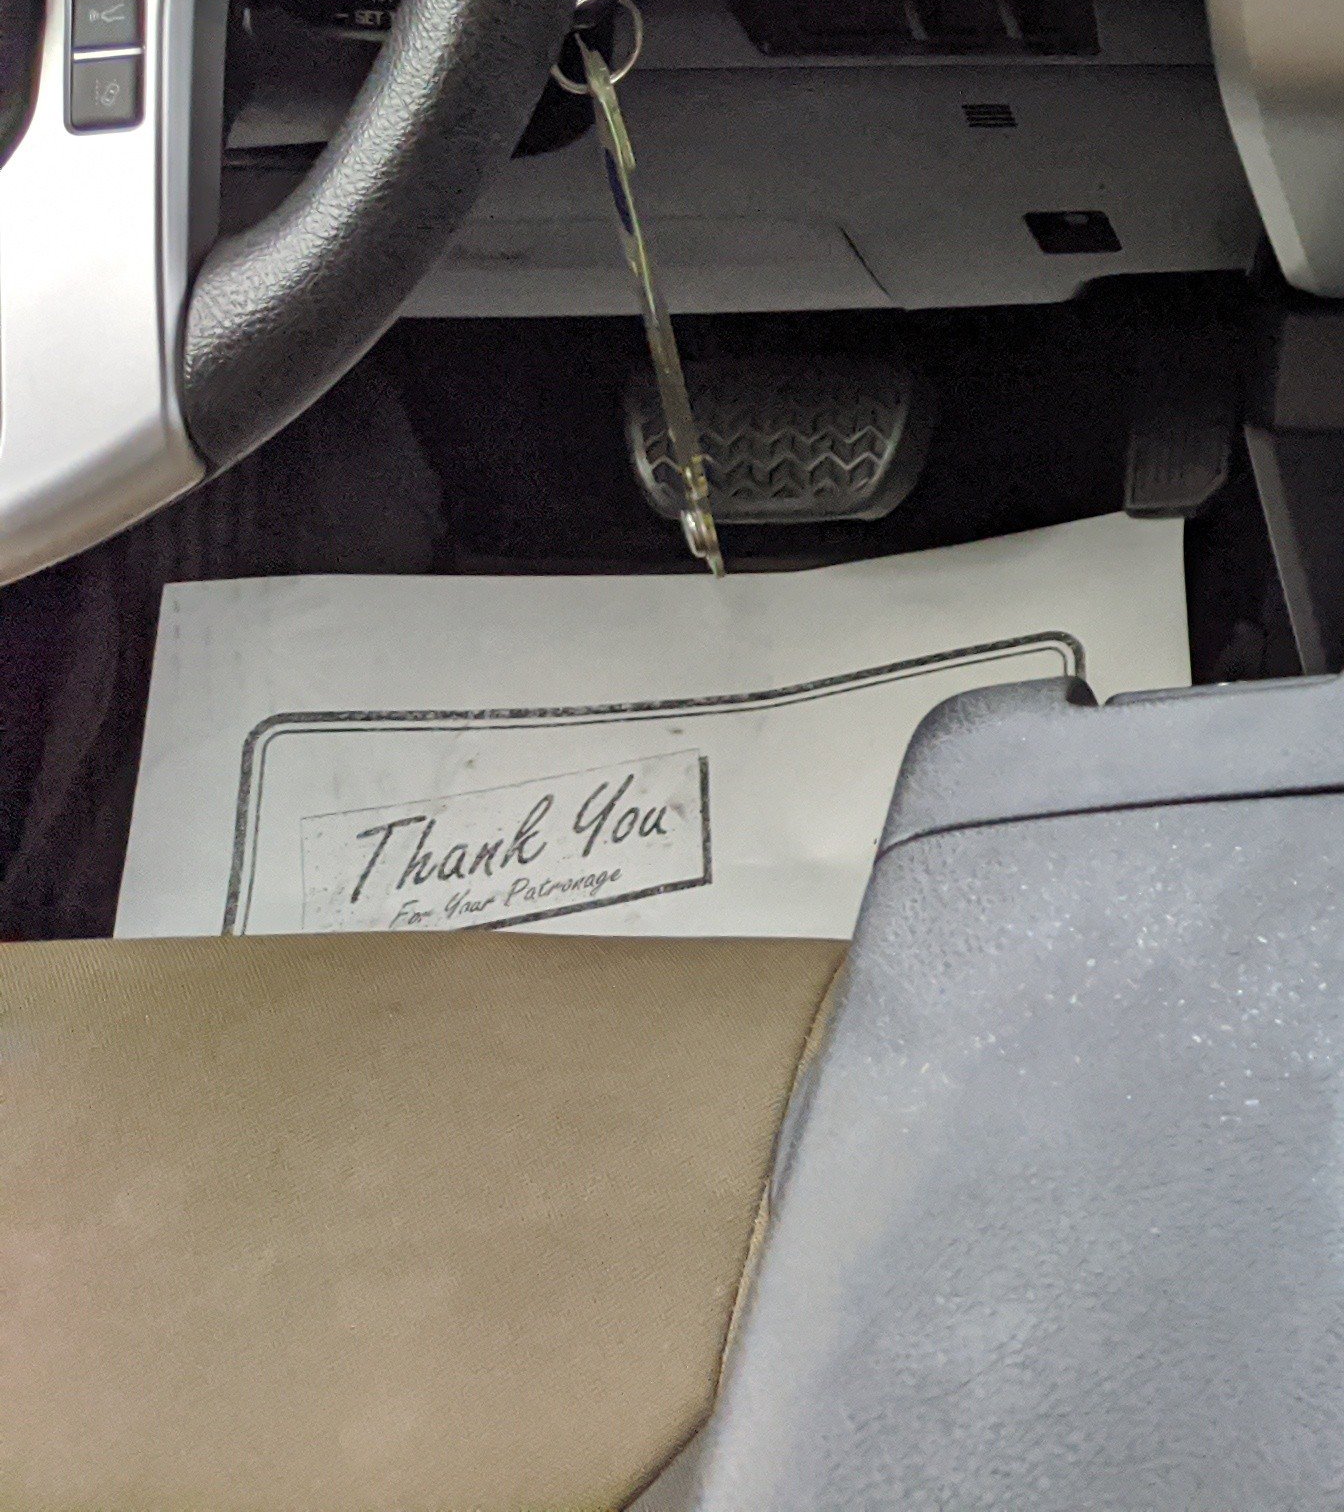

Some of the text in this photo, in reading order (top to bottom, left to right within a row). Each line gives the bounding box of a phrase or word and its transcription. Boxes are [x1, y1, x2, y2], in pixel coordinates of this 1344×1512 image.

[349, 773, 671, 904] Thank You
[443, 888, 496, 918] Your
[505, 867, 625, 908] Patronage
